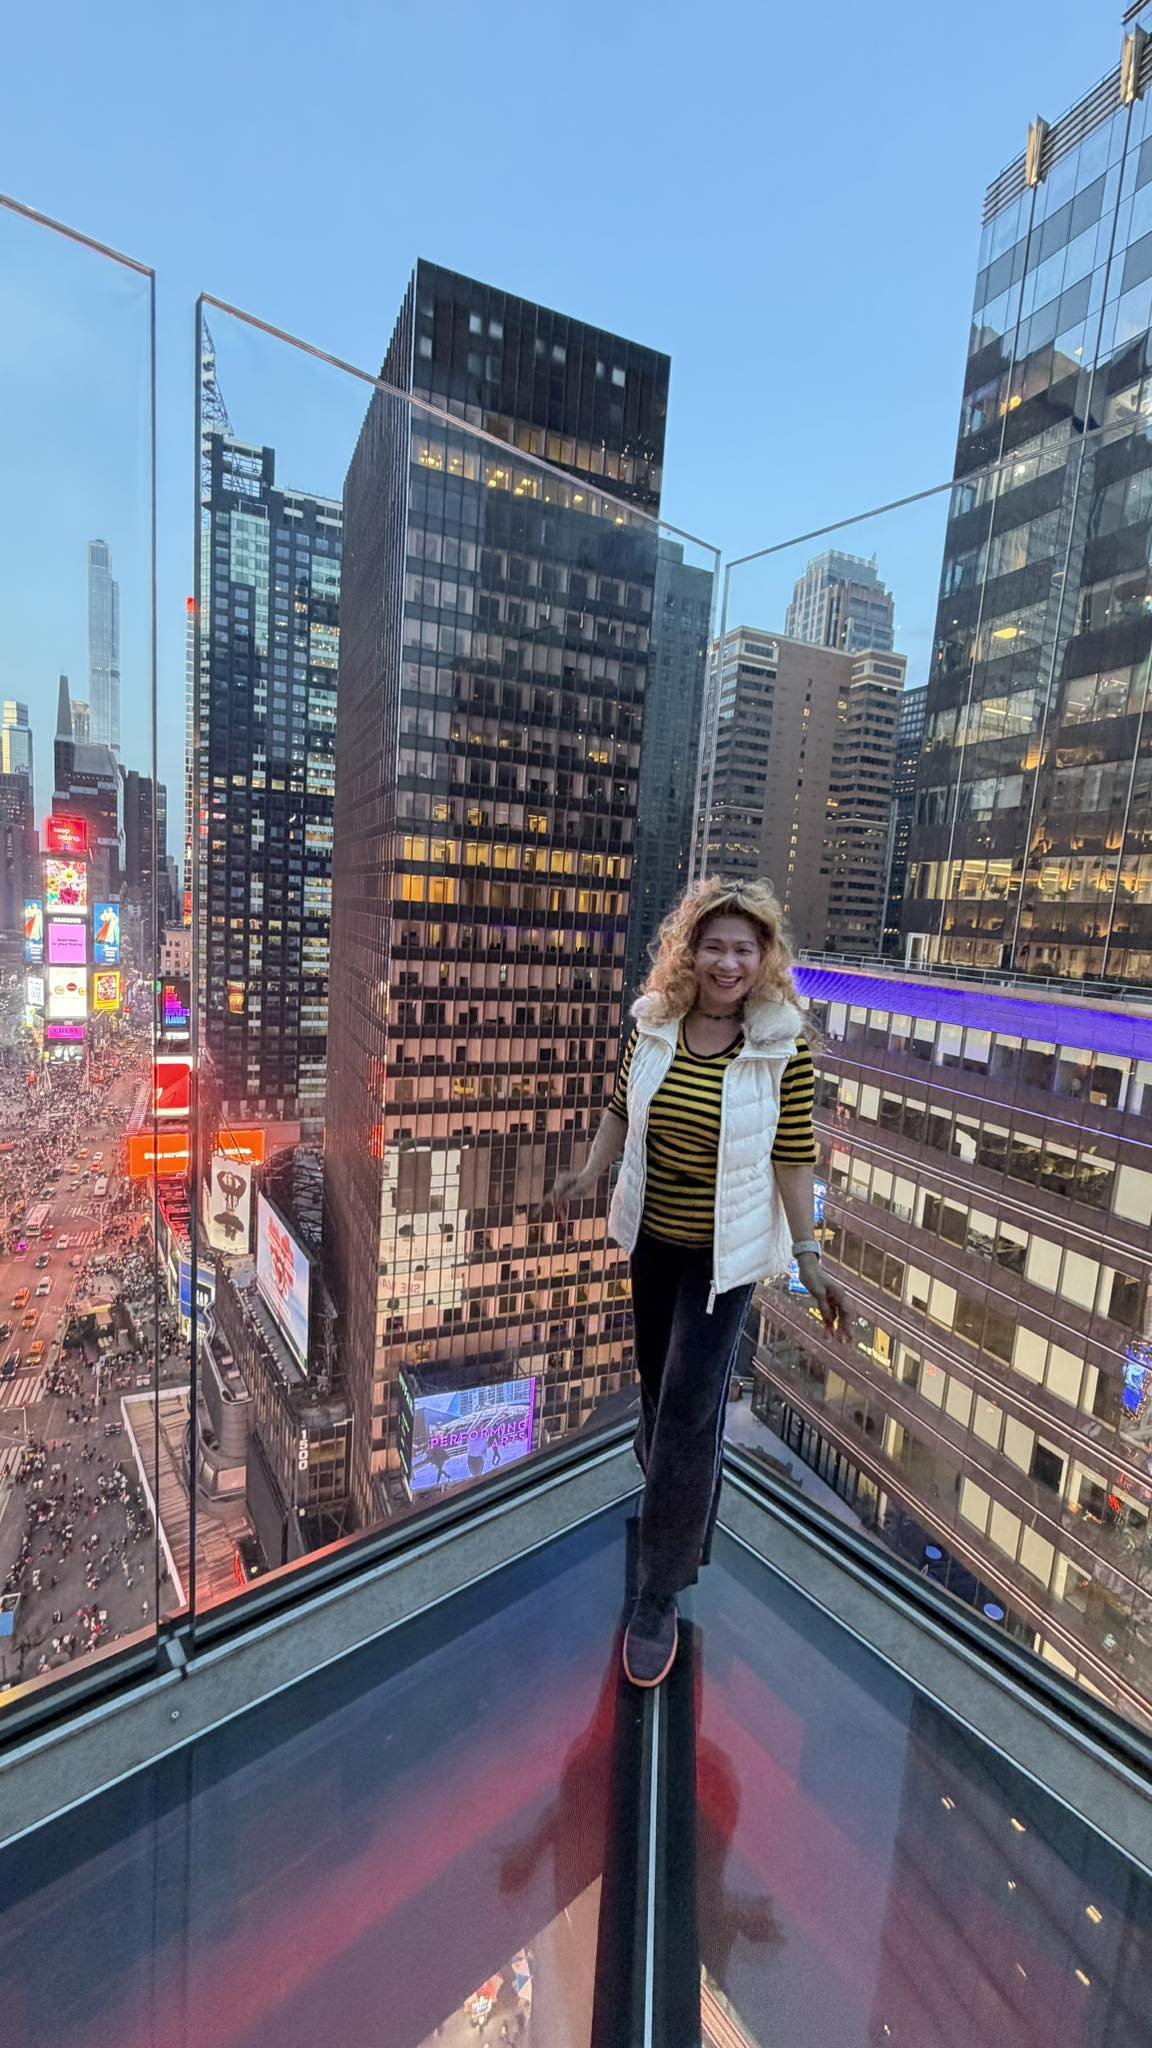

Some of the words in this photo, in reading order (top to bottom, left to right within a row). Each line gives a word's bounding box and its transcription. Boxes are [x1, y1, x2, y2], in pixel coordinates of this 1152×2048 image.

[430, 1420, 527, 1449] PERFORMING
[490, 1432, 527, 1449] ARTS
[297, 1429, 309, 1471] 1500
